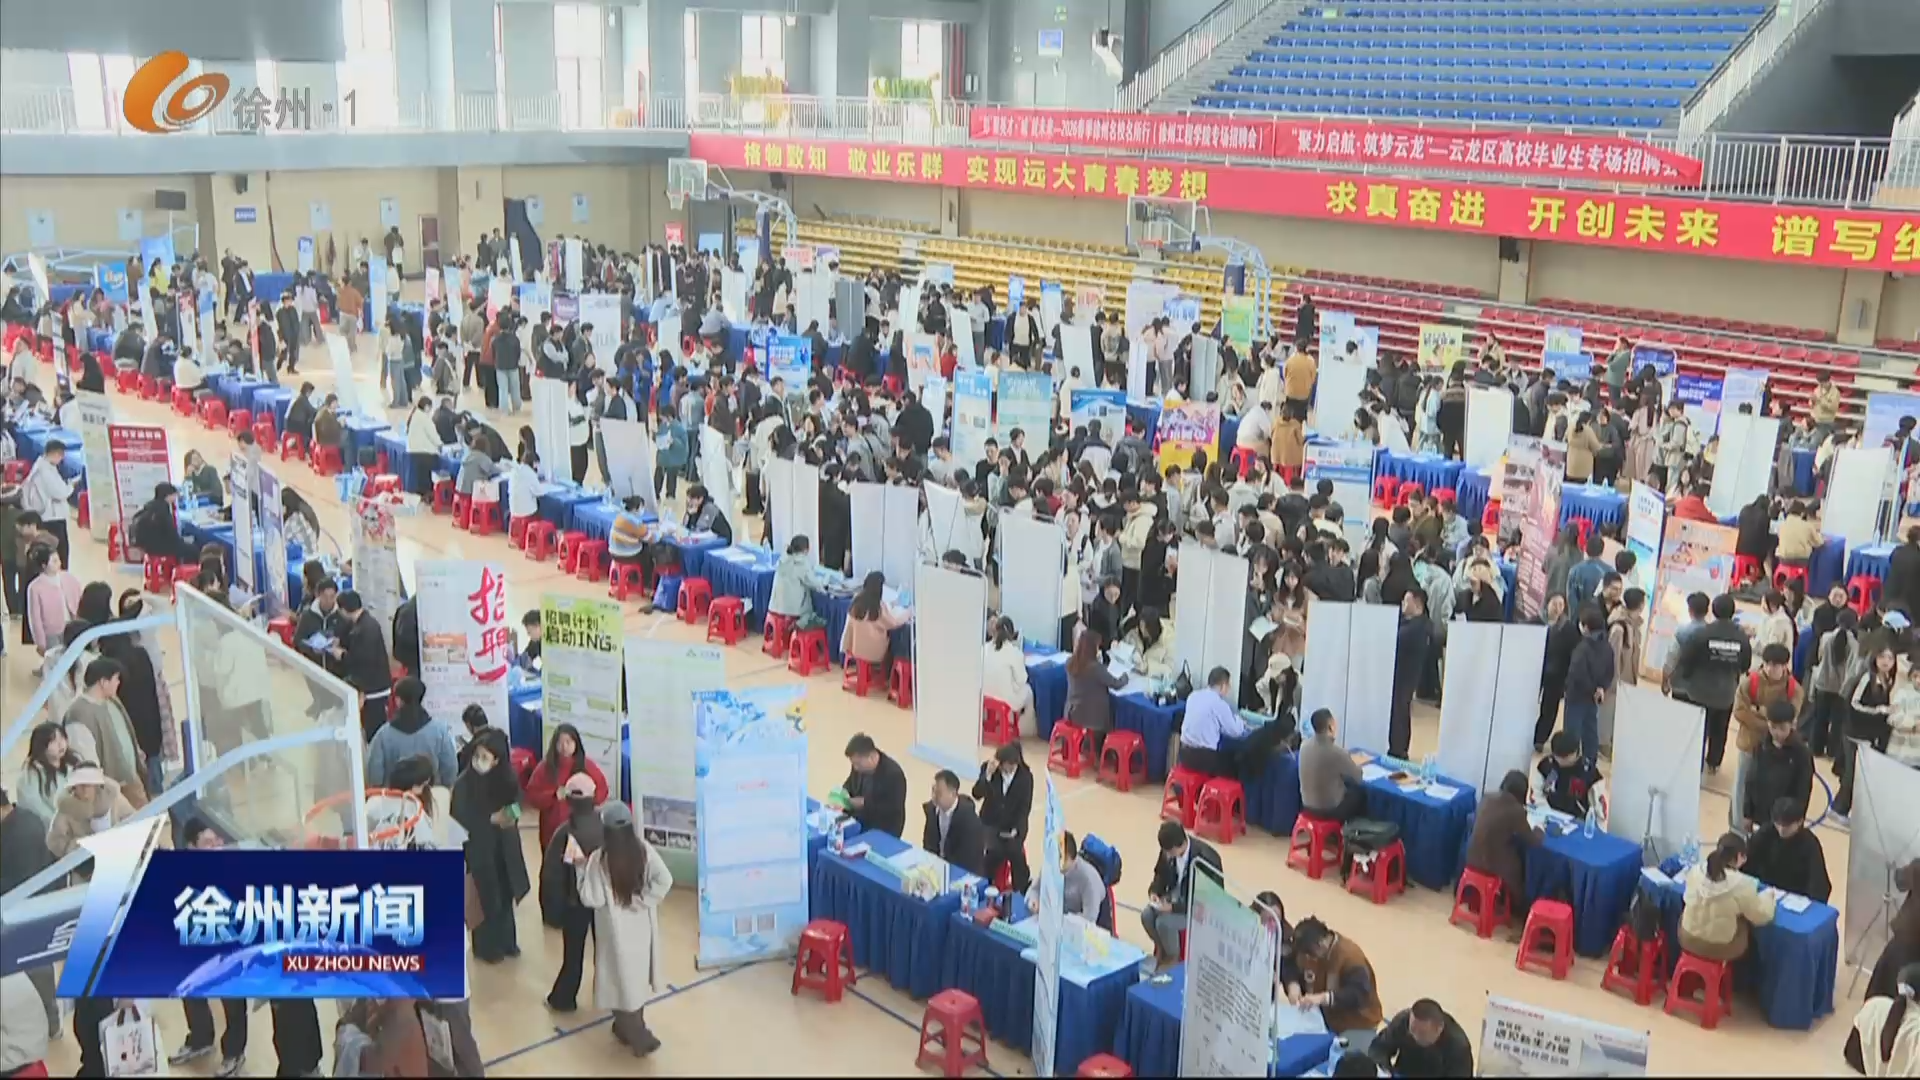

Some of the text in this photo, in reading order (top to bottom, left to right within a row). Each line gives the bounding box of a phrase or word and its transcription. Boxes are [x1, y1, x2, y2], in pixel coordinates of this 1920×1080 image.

[744, 141, 827, 171] 格物致知
[848, 147, 943, 180] 敬业乐群
[967, 154, 1208, 201] 实现远大青春梦想
[1326, 180, 1486, 228] 求真奋进
[1527, 196, 1720, 248] 开创未来
